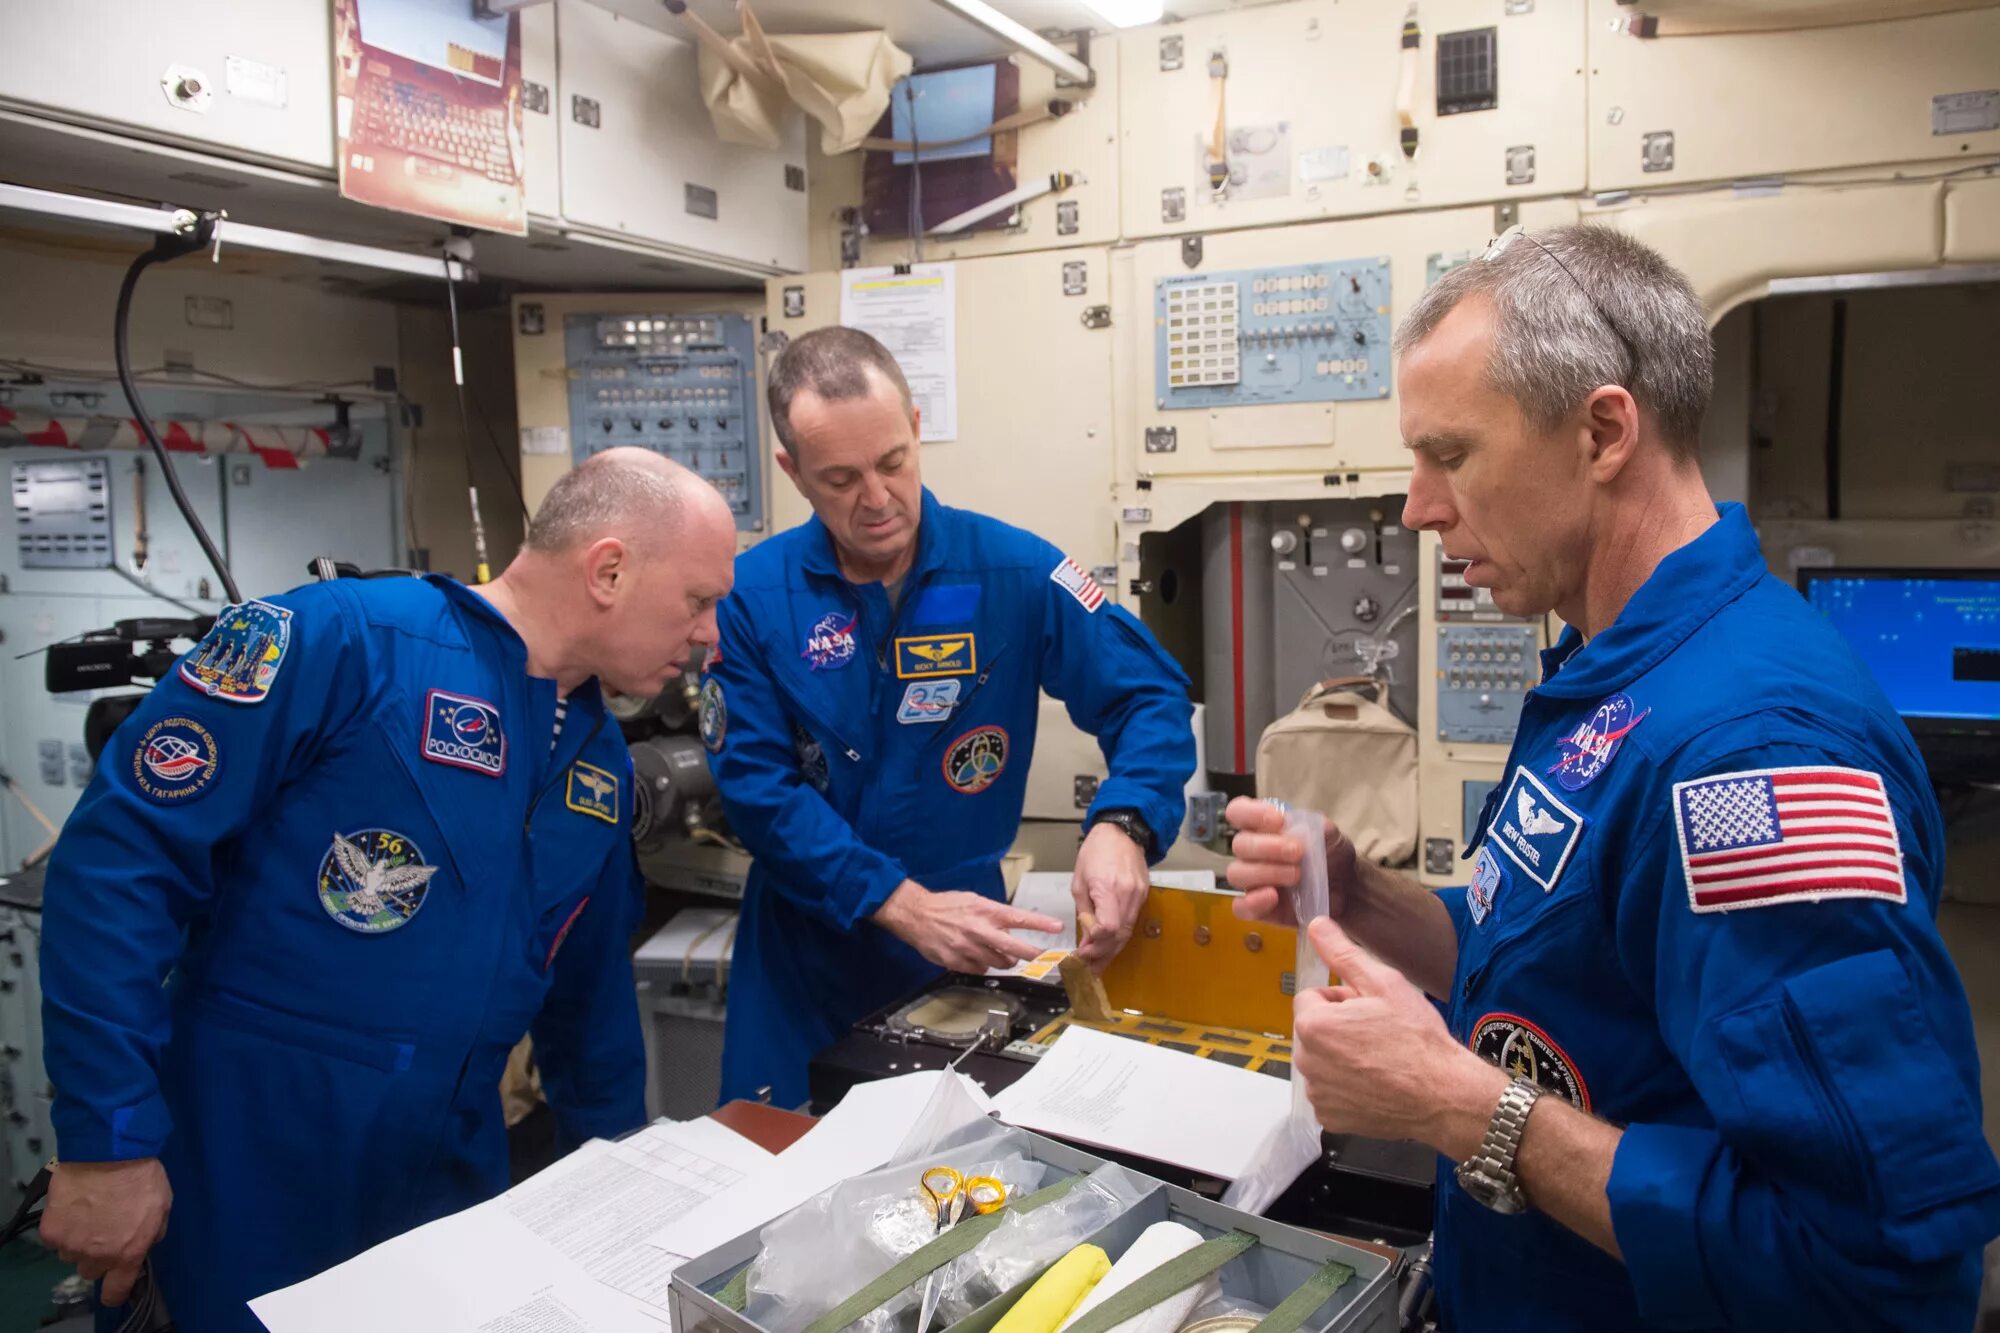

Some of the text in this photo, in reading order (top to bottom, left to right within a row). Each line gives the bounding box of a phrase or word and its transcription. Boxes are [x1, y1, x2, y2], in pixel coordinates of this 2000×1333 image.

[808, 633, 855, 652] NASA
[905, 686, 950, 717] 25
[428, 738, 500, 768] РОСКОСМОС
[1570, 722, 1613, 763] NASA
[151, 785, 198, 798] ГАГАРИНА
[376, 832, 404, 854] 56
[1502, 821, 1540, 867] DREW FEUSTEL
[390, 872, 418, 887] ARNOLD
